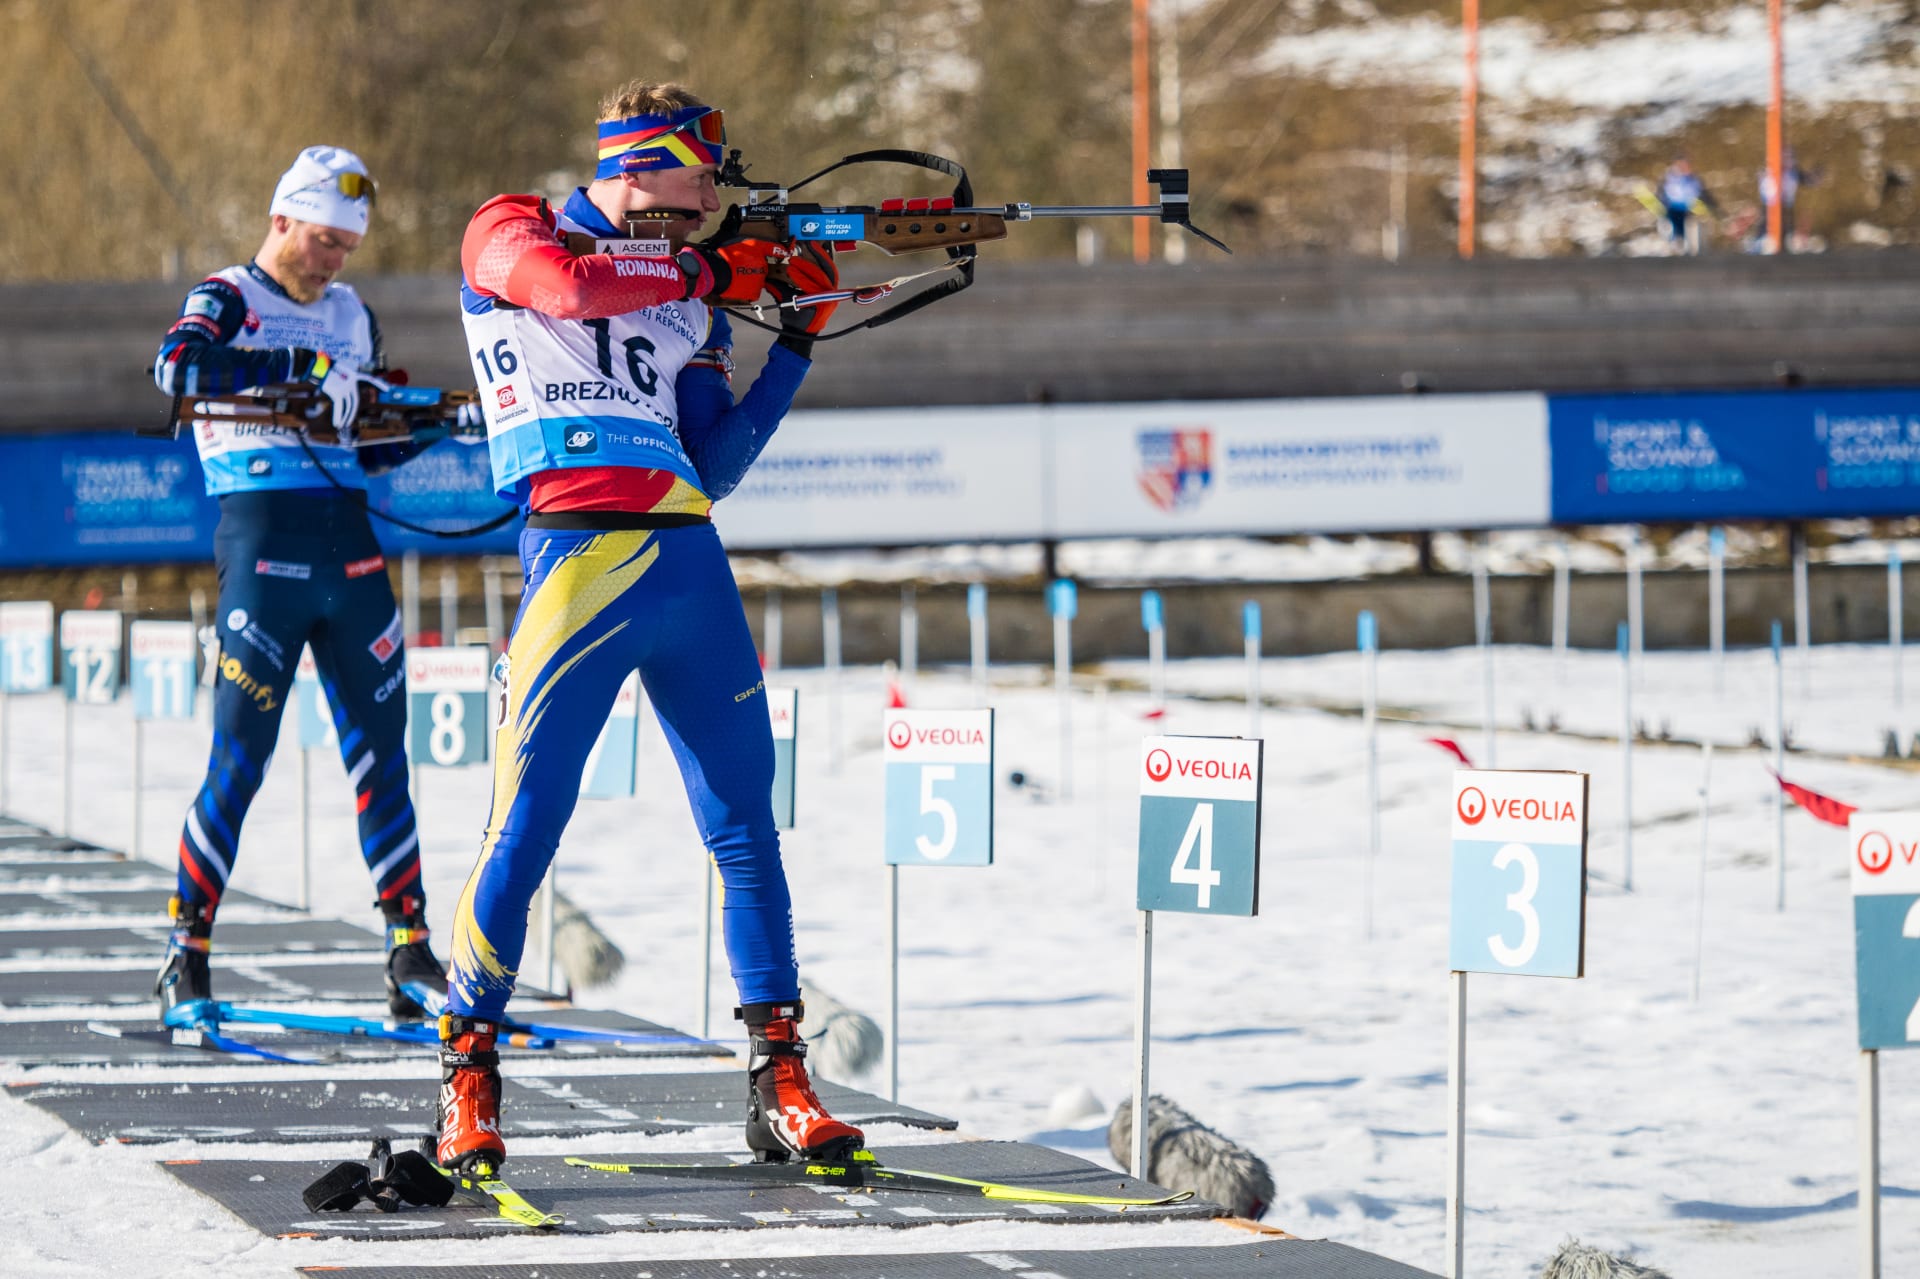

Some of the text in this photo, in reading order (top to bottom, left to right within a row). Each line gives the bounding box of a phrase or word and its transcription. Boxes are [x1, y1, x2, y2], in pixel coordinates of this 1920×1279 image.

[613, 259, 680, 282] ROMANIA
[622, 243, 668, 253] ASCENT
[476, 339, 518, 384] 16
[582, 317, 660, 397] 16
[606, 433, 630, 445] THE
[632, 435, 677, 458] OFFICIAL
[4, 639, 42, 690] 13
[68, 648, 114, 703] 12
[143, 660, 184, 719] 11
[429, 692, 466, 766] 8
[916, 728, 984, 745] VEOLIA
[1177, 759, 1252, 780] VEOLIA
[915, 765, 957, 860] 5
[1491, 798, 1576, 822] VEOLIA
[1170, 802, 1221, 909] 4
[1487, 842, 1540, 967] 3
[805, 1165, 847, 1177] FISCHER
